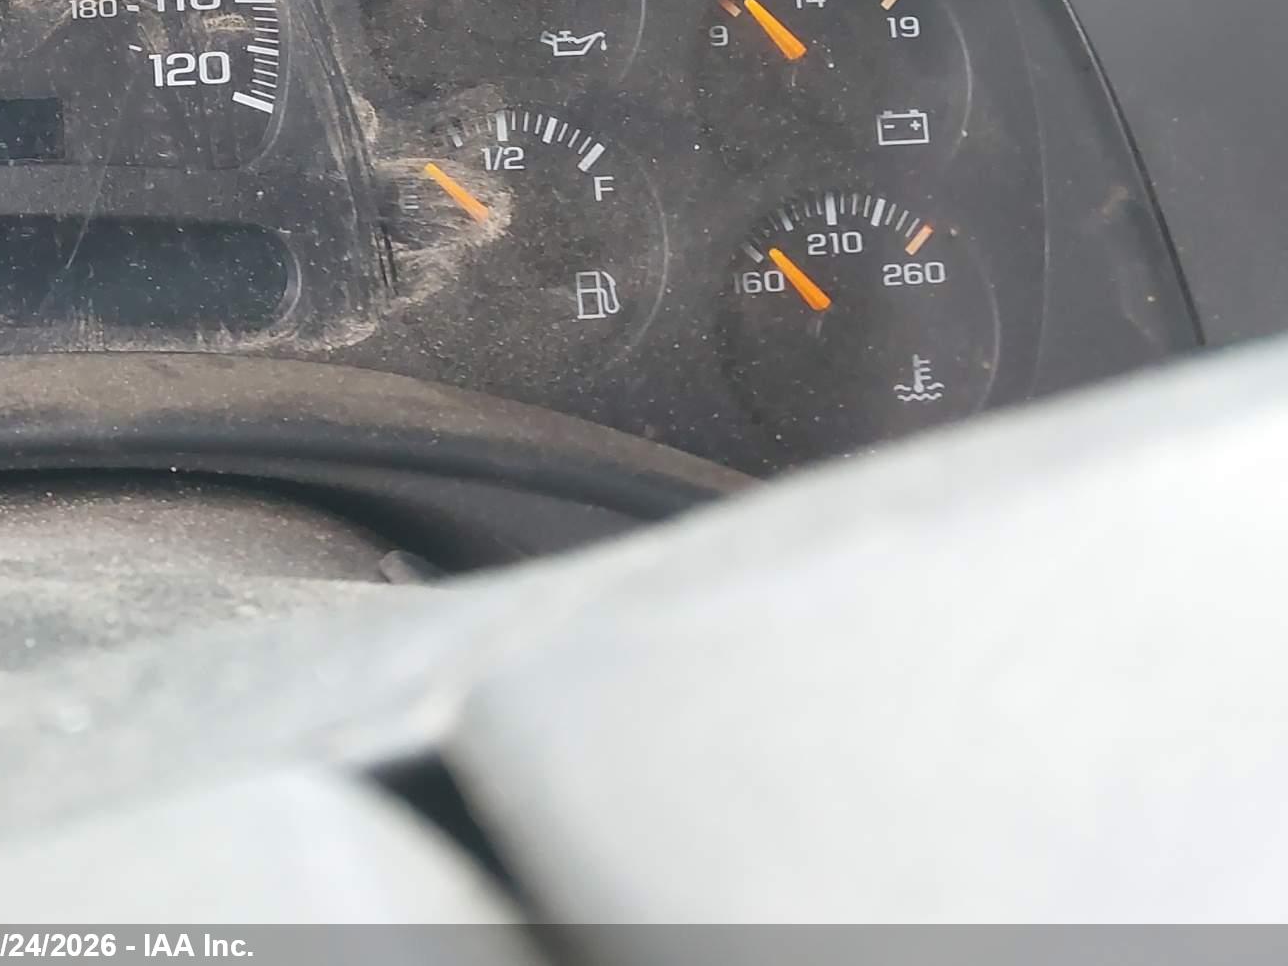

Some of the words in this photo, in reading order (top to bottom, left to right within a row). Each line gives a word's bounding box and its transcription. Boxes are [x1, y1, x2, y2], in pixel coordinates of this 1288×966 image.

[712, 26, 728, 45] 9
[887, 17, 919, 37] 19
[149, 52, 230, 86] 120
[481, 147, 524, 170] 1/2
[594, 177, 613, 201] F
[808, 232, 862, 254] 210
[883, 262, 945, 285] 260
